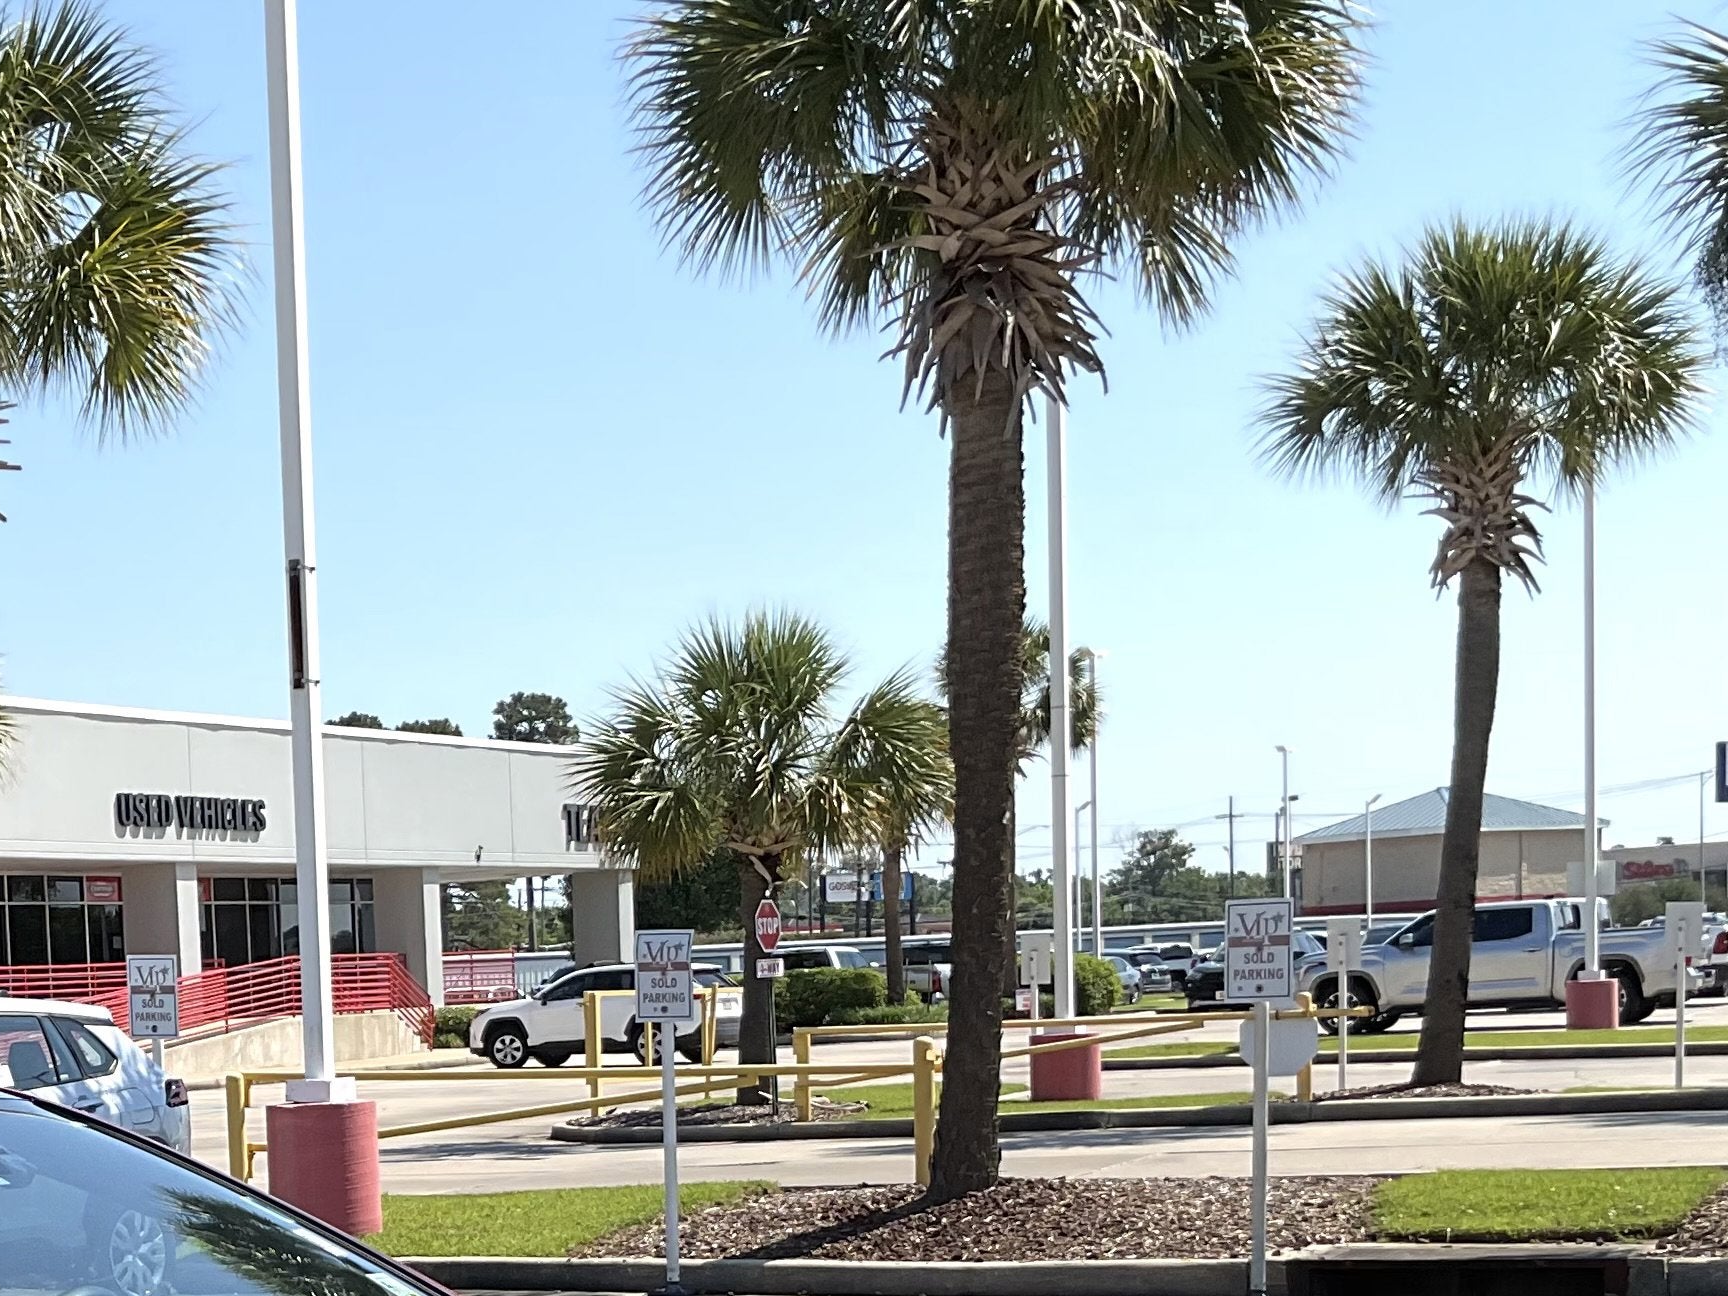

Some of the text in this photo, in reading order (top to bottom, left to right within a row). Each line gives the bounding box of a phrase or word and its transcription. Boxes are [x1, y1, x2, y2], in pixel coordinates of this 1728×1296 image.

[114, 793, 267, 832] USED VEHICLES
[757, 917, 779, 935] STOP
[1243, 951, 1275, 965] SOLD
[1233, 967, 1284, 981] PARKING
[651, 977, 678, 988] SOLD
[141, 998, 164, 1009] SOLD
[642, 992, 686, 1004] PARKING
[135, 1011, 172, 1022] PARKING
